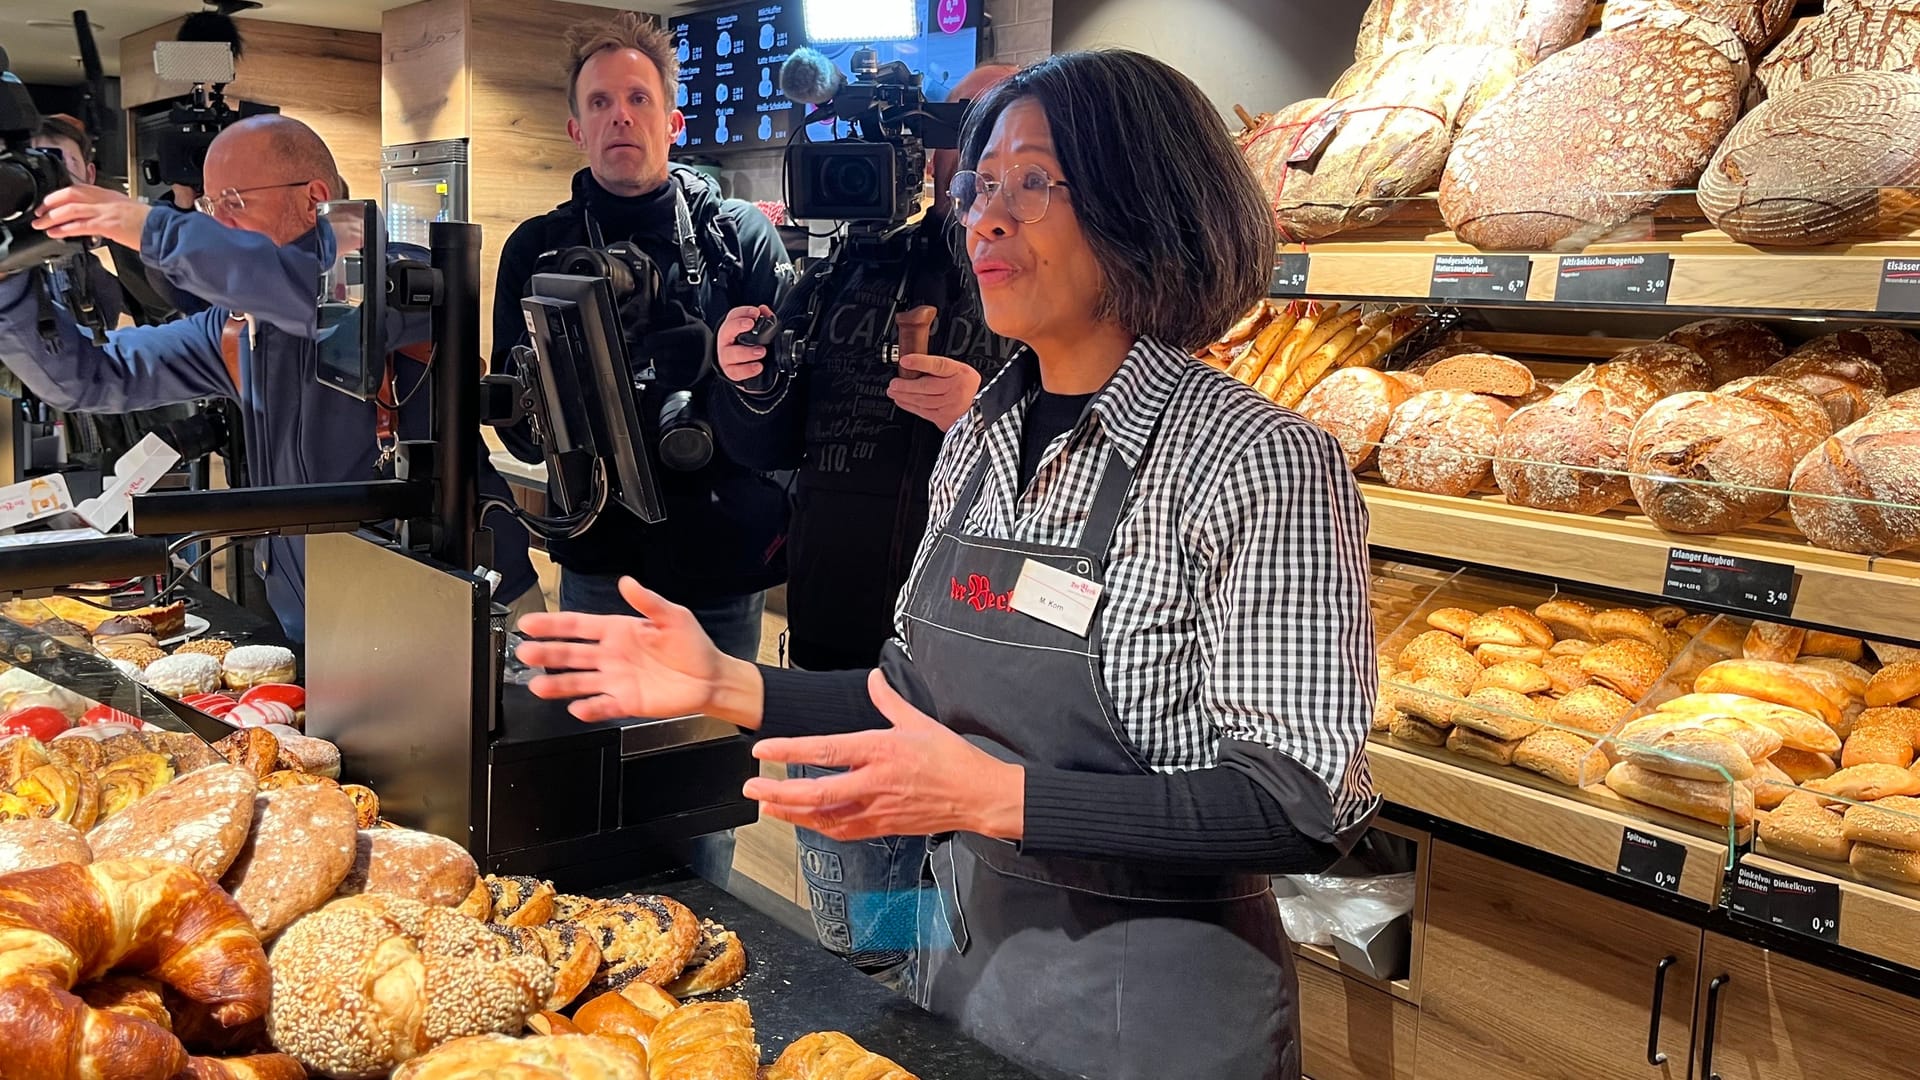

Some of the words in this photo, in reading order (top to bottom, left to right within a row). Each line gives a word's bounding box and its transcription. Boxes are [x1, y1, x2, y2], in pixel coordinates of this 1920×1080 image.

[1436, 256, 1485, 267] Handgeschöpftes
[1561, 256, 1607, 267] Altfränkischer
[1607, 255, 1645, 267] Roggenlaib
[1887, 260, 1920, 271] Elsässer
[1508, 280, 1524, 293] 6,79
[1646, 279, 1665, 293] 3,60
[1671, 549, 1702, 563] Erlanger
[1702, 553, 1735, 567] Bergbrot
[1766, 590, 1788, 606] 3,40
[1626, 831, 1658, 849] Spitzwerk
[1655, 871, 1677, 887] 0,90
[1736, 876, 1769, 893] brötchen
[1812, 917, 1835, 935] 0,90
